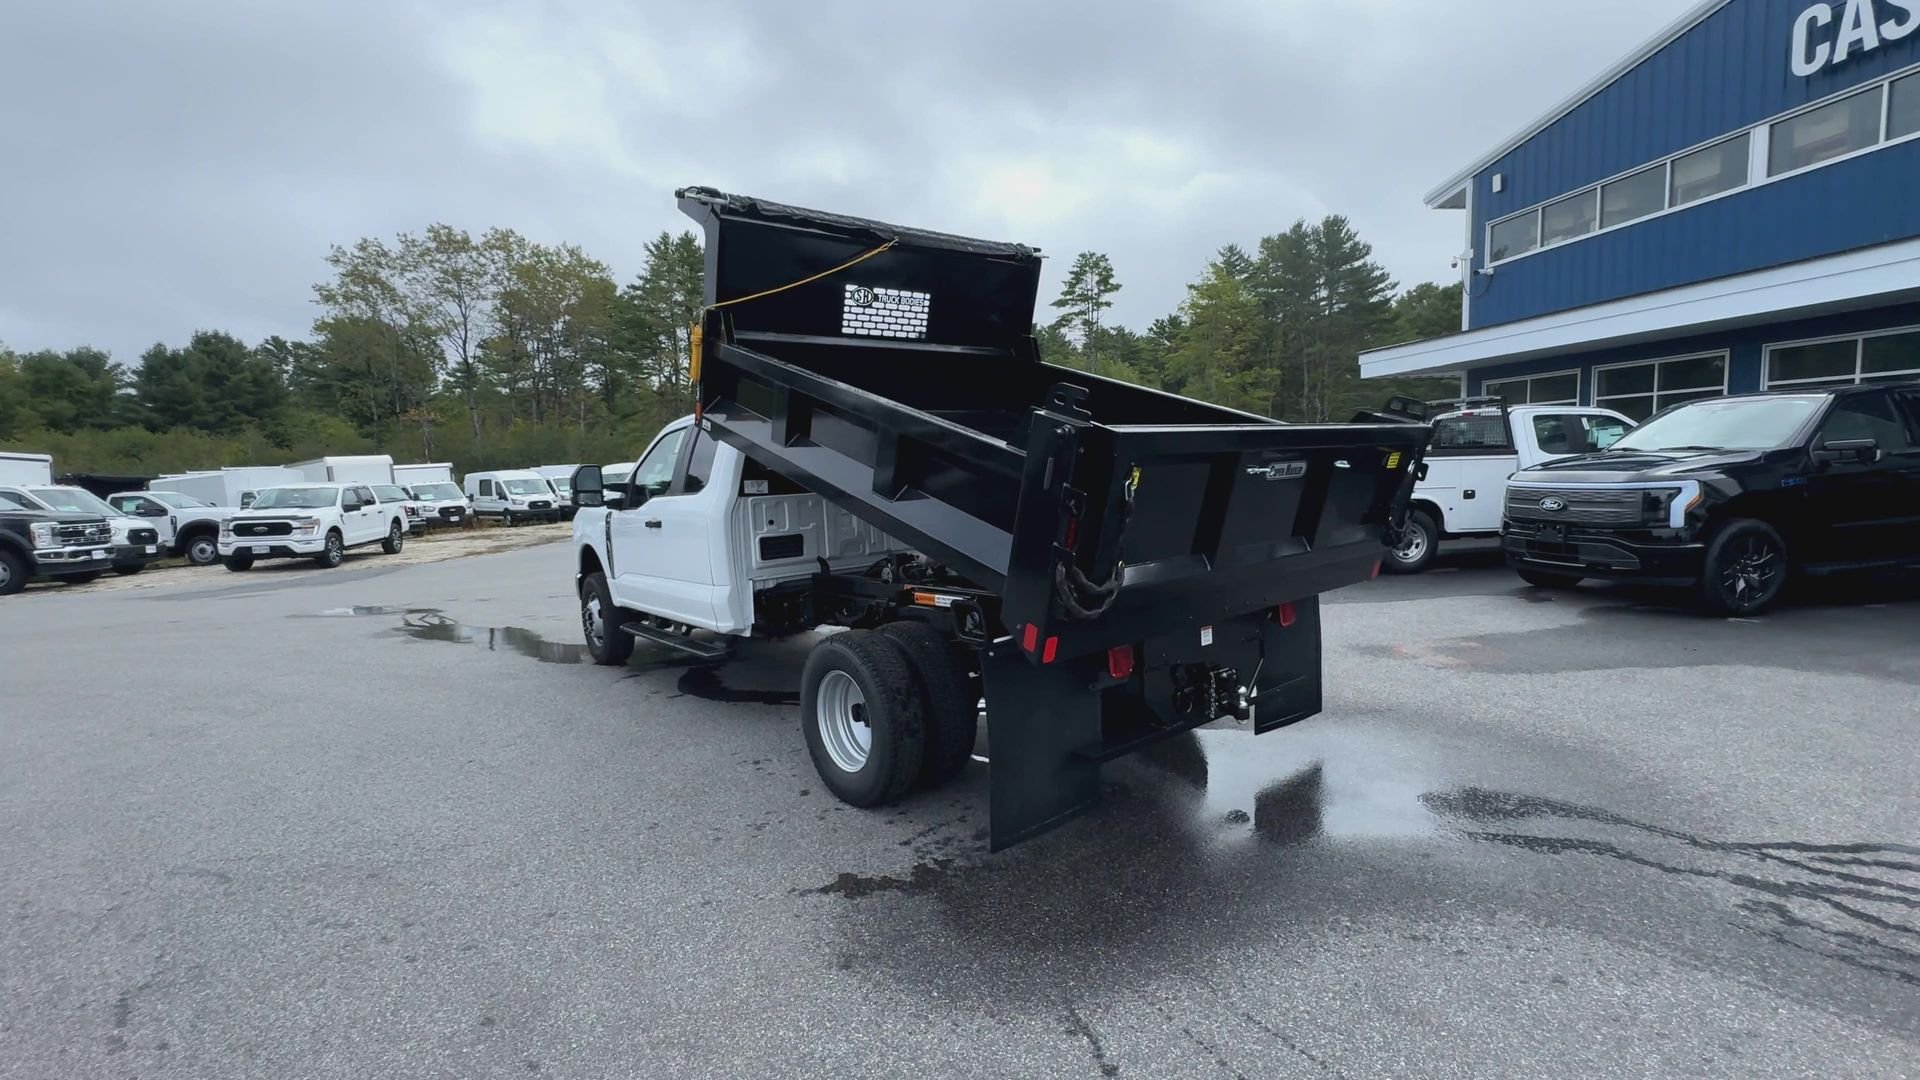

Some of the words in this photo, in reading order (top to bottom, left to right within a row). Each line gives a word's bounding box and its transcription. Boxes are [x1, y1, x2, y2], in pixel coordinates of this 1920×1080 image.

[1791, 0, 1920, 76] CAS
[878, 294, 900, 305] TRUCK
[900, 296, 924, 307] BODIES
